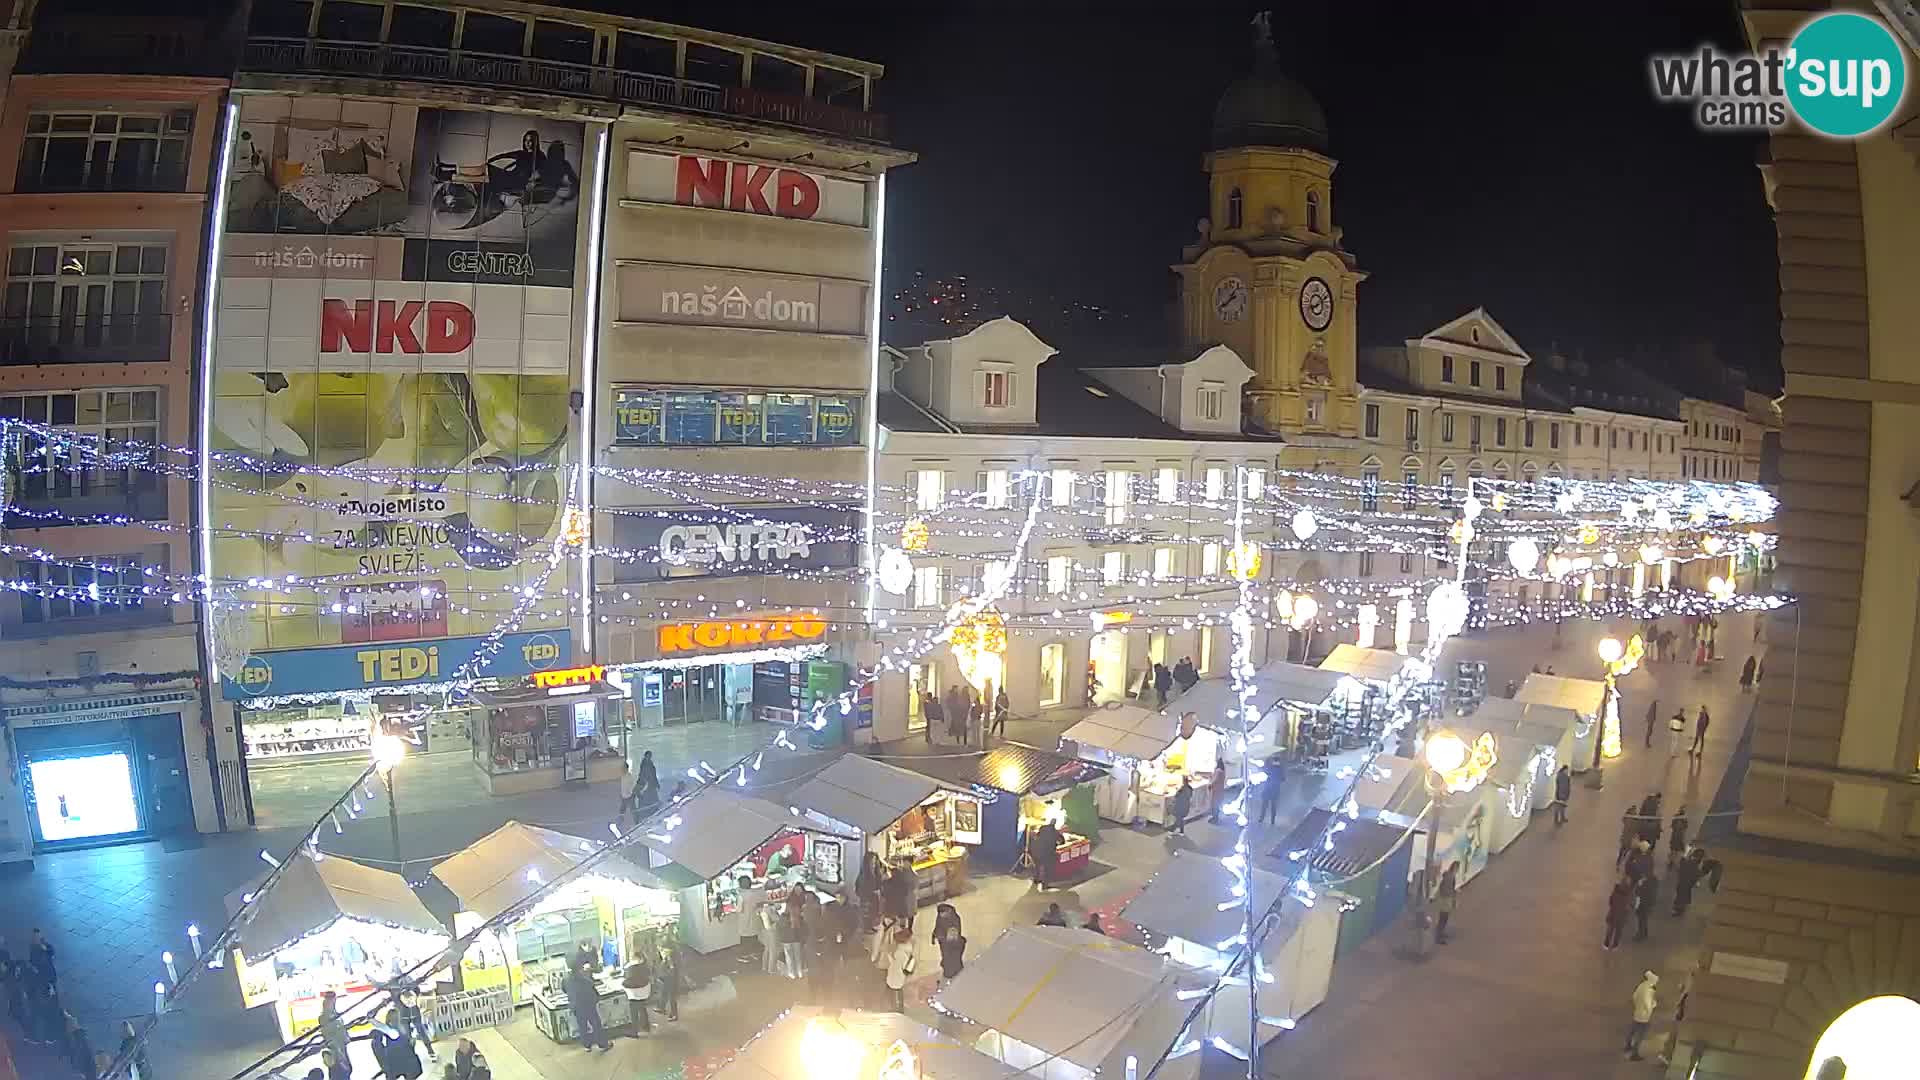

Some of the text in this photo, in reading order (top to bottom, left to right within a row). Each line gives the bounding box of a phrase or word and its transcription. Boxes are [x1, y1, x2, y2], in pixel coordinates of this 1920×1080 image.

[677, 155, 820, 219] NKD
[254, 247, 366, 269] naš dom
[447, 250, 534, 276] CENTRA
[661, 285, 816, 323] naš dom
[321, 298, 476, 353] NKD
[368, 523, 450, 548] DNEVNO
[660, 524, 811, 563] CENTRA
[358, 547, 425, 574] SVJEŽE
[659, 611, 827, 652] KORZO
[357, 646, 439, 684] TEDi
[522, 644, 560, 662] TEDi
